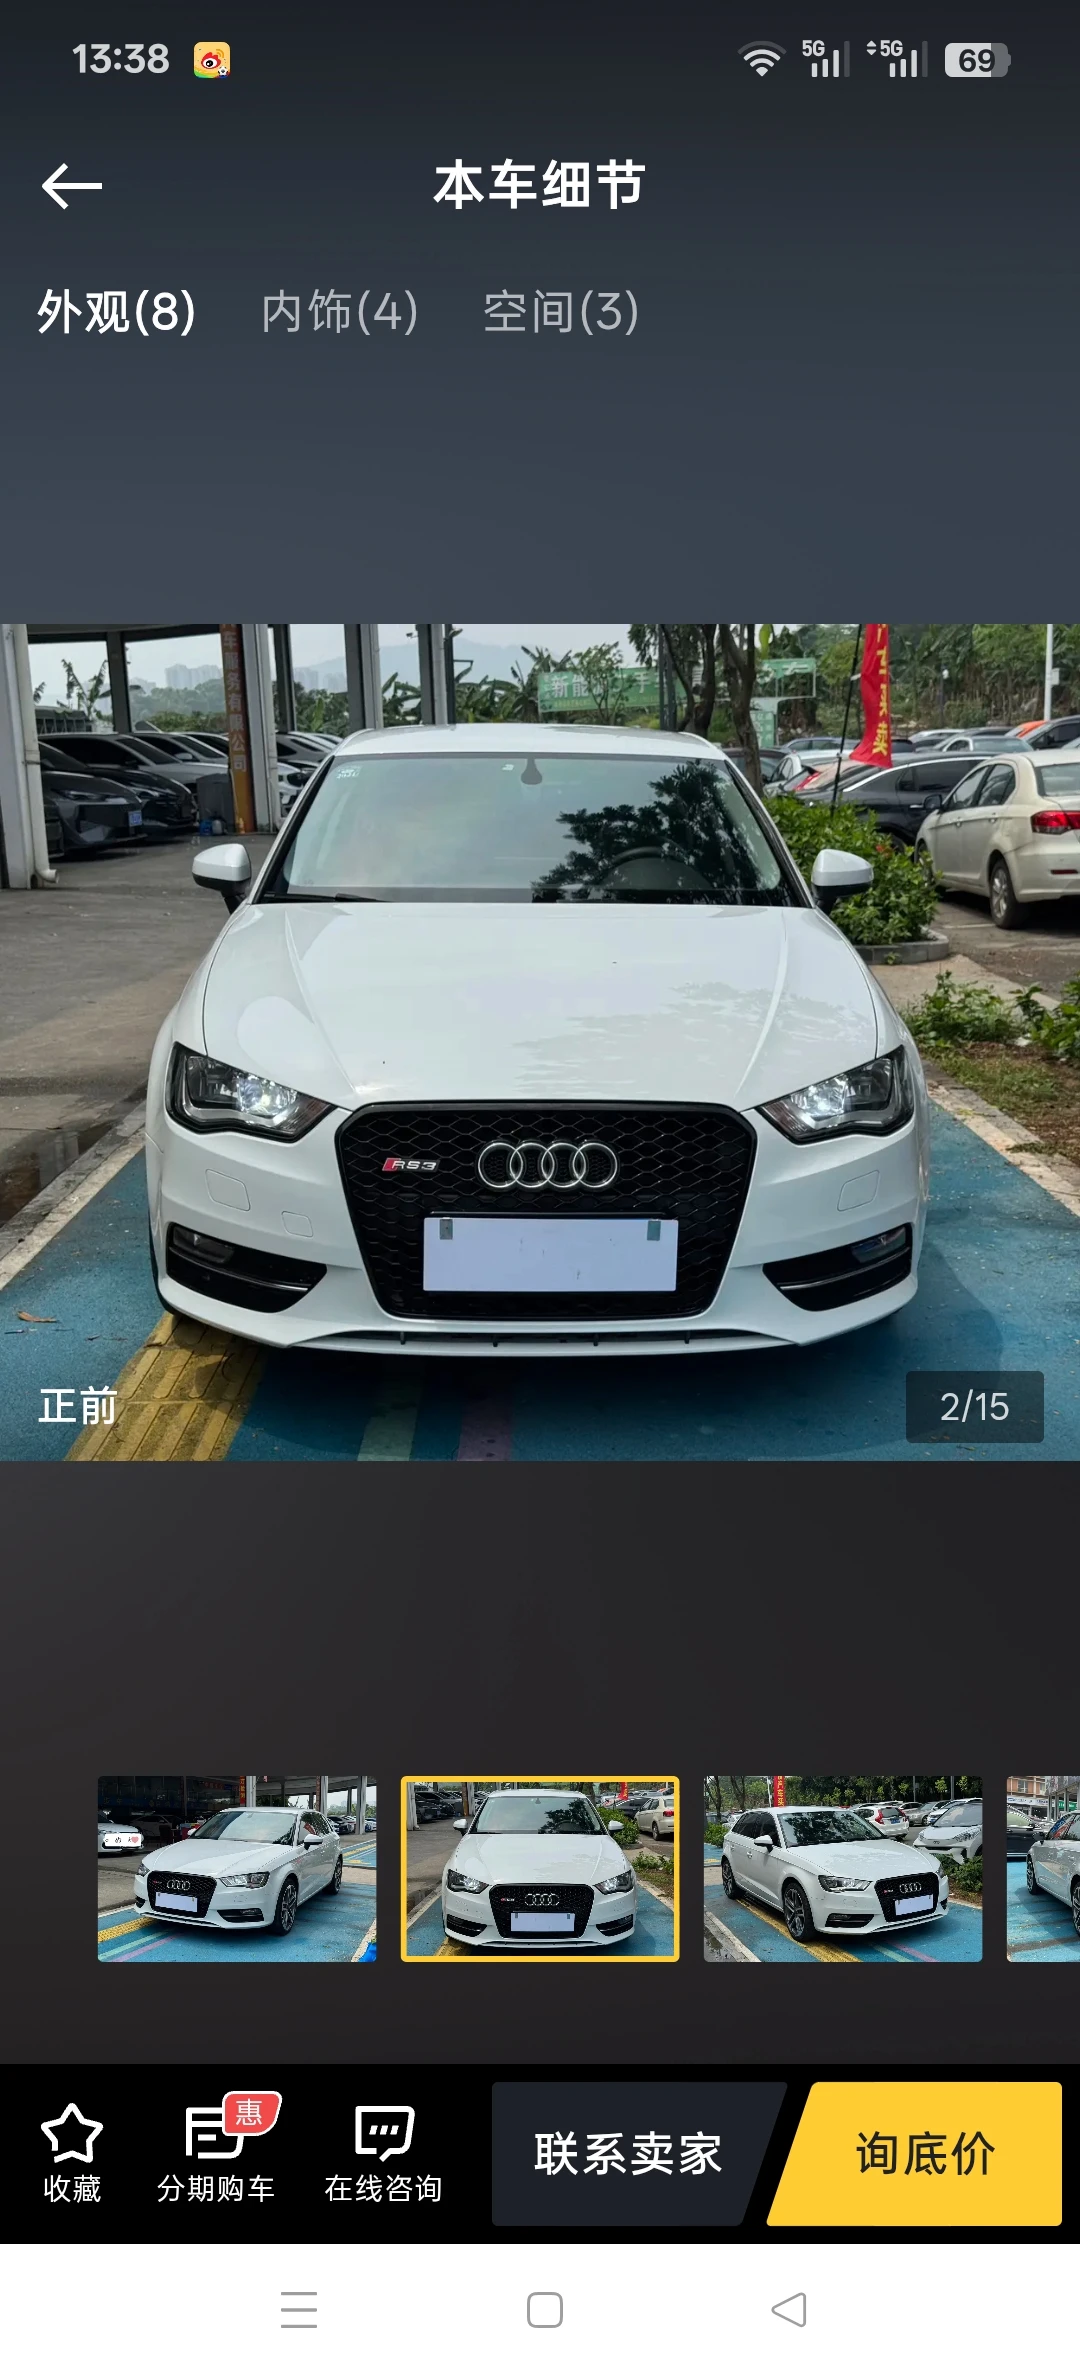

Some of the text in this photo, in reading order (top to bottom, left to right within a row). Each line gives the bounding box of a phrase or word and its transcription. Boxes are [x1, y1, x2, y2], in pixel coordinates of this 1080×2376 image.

[73, 43, 170, 74] 13:38
[802, 39, 826, 57] 5G
[879, 39, 904, 57] 5G
[958, 48, 996, 73] 69
[432, 157, 647, 210] 本车细节
[36, 287, 196, 337] 外观(8)
[262, 287, 418, 337] 内饰(4)
[483, 287, 639, 337] 空间(3)
[220, 624, 248, 773] 车服务有限公司
[389, 1159, 438, 1172] RS3
[235, 2097, 263, 2126] 惠
[533, 2129, 723, 2176] 联系卖家
[855, 2129, 997, 2176] 询底价
[43, 2173, 102, 2204] 收藏
[156, 2173, 276, 2204] 分期购车
[324, 2173, 443, 2204] 在线咨询
